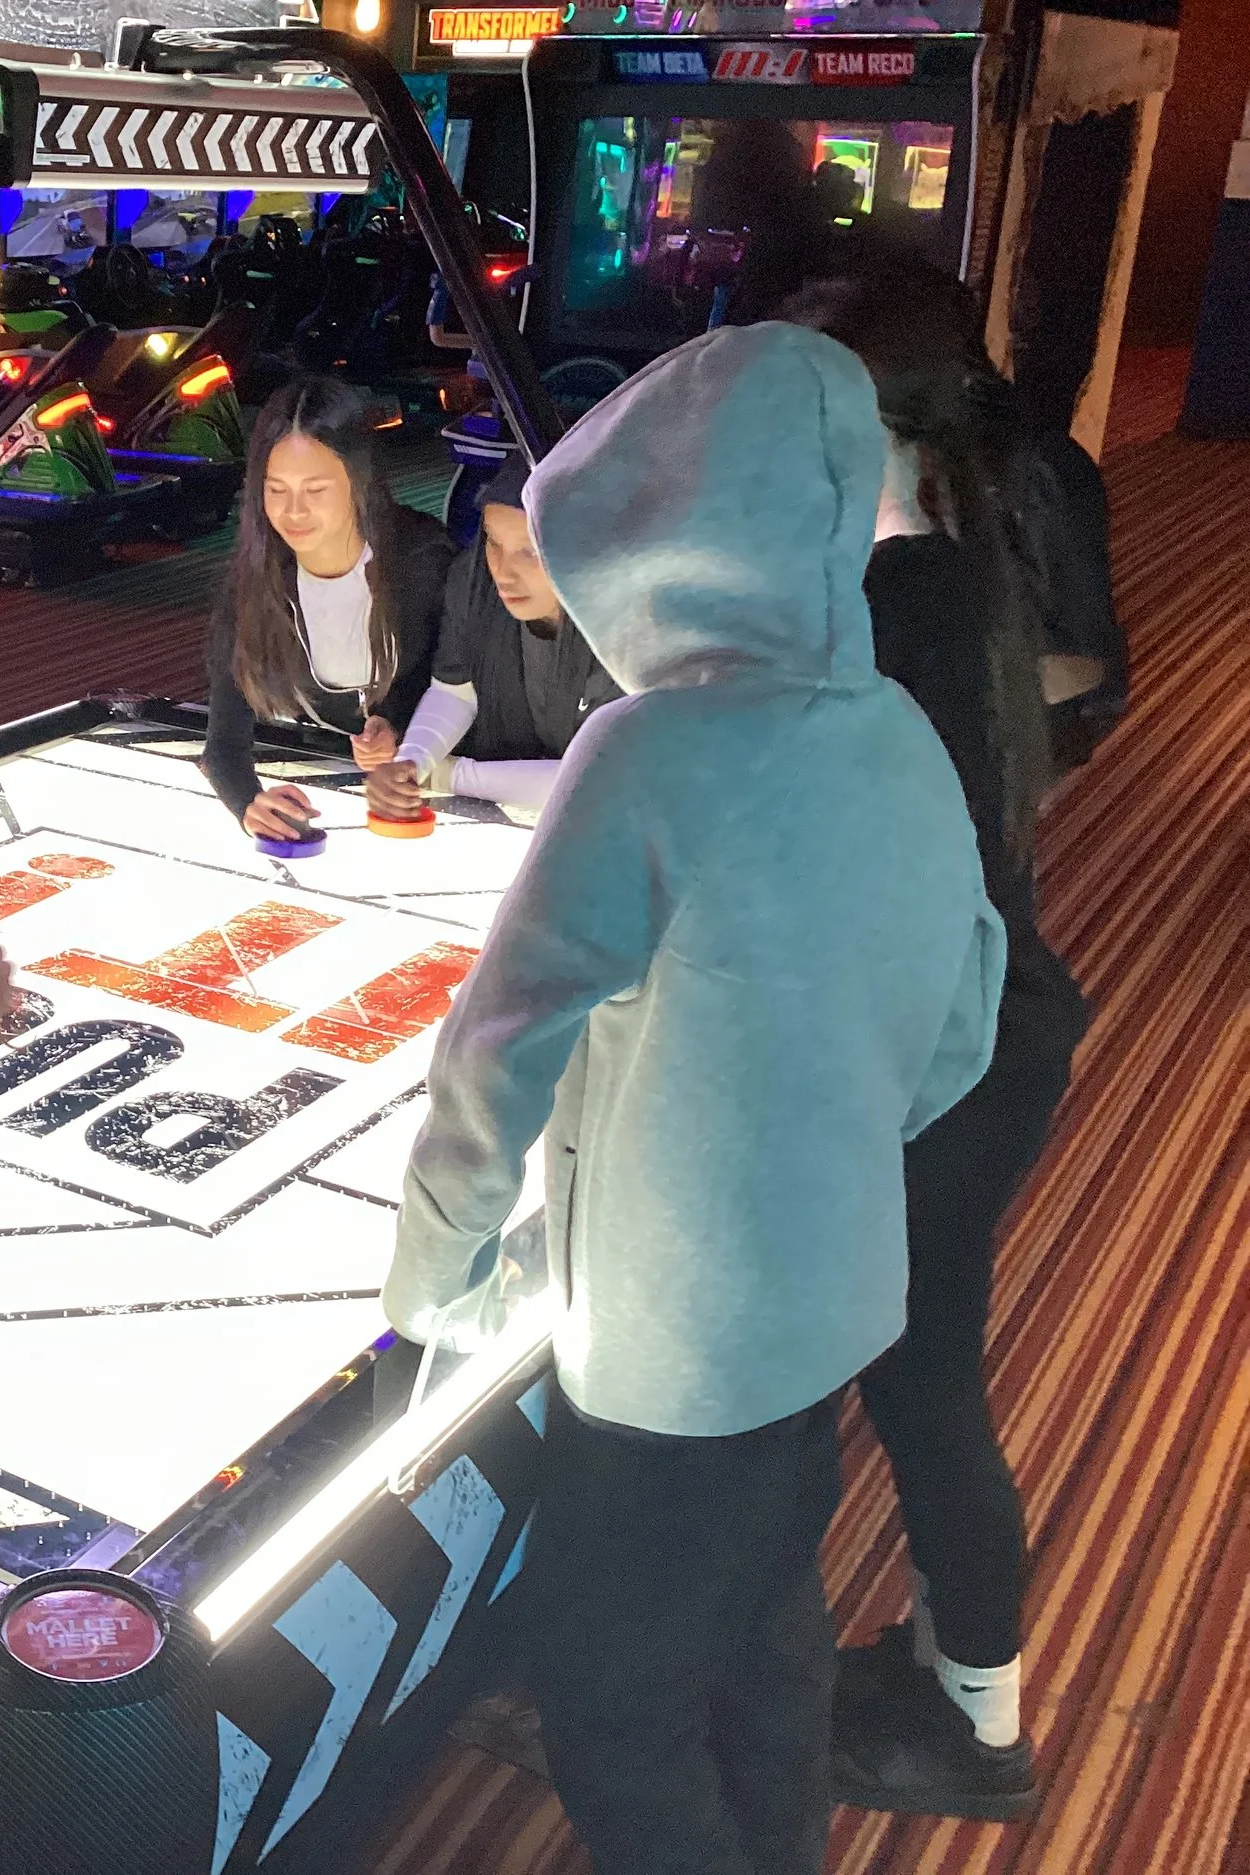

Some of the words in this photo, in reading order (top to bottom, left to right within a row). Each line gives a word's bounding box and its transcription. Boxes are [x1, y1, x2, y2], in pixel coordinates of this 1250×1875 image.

[432, 11, 559, 40] TRANSFORME
[616, 51, 661, 74] TEAM
[815, 52, 863, 75] TEAM
[26, 1616, 131, 1636] MALLET
[46, 1629, 118, 1648] HERE
